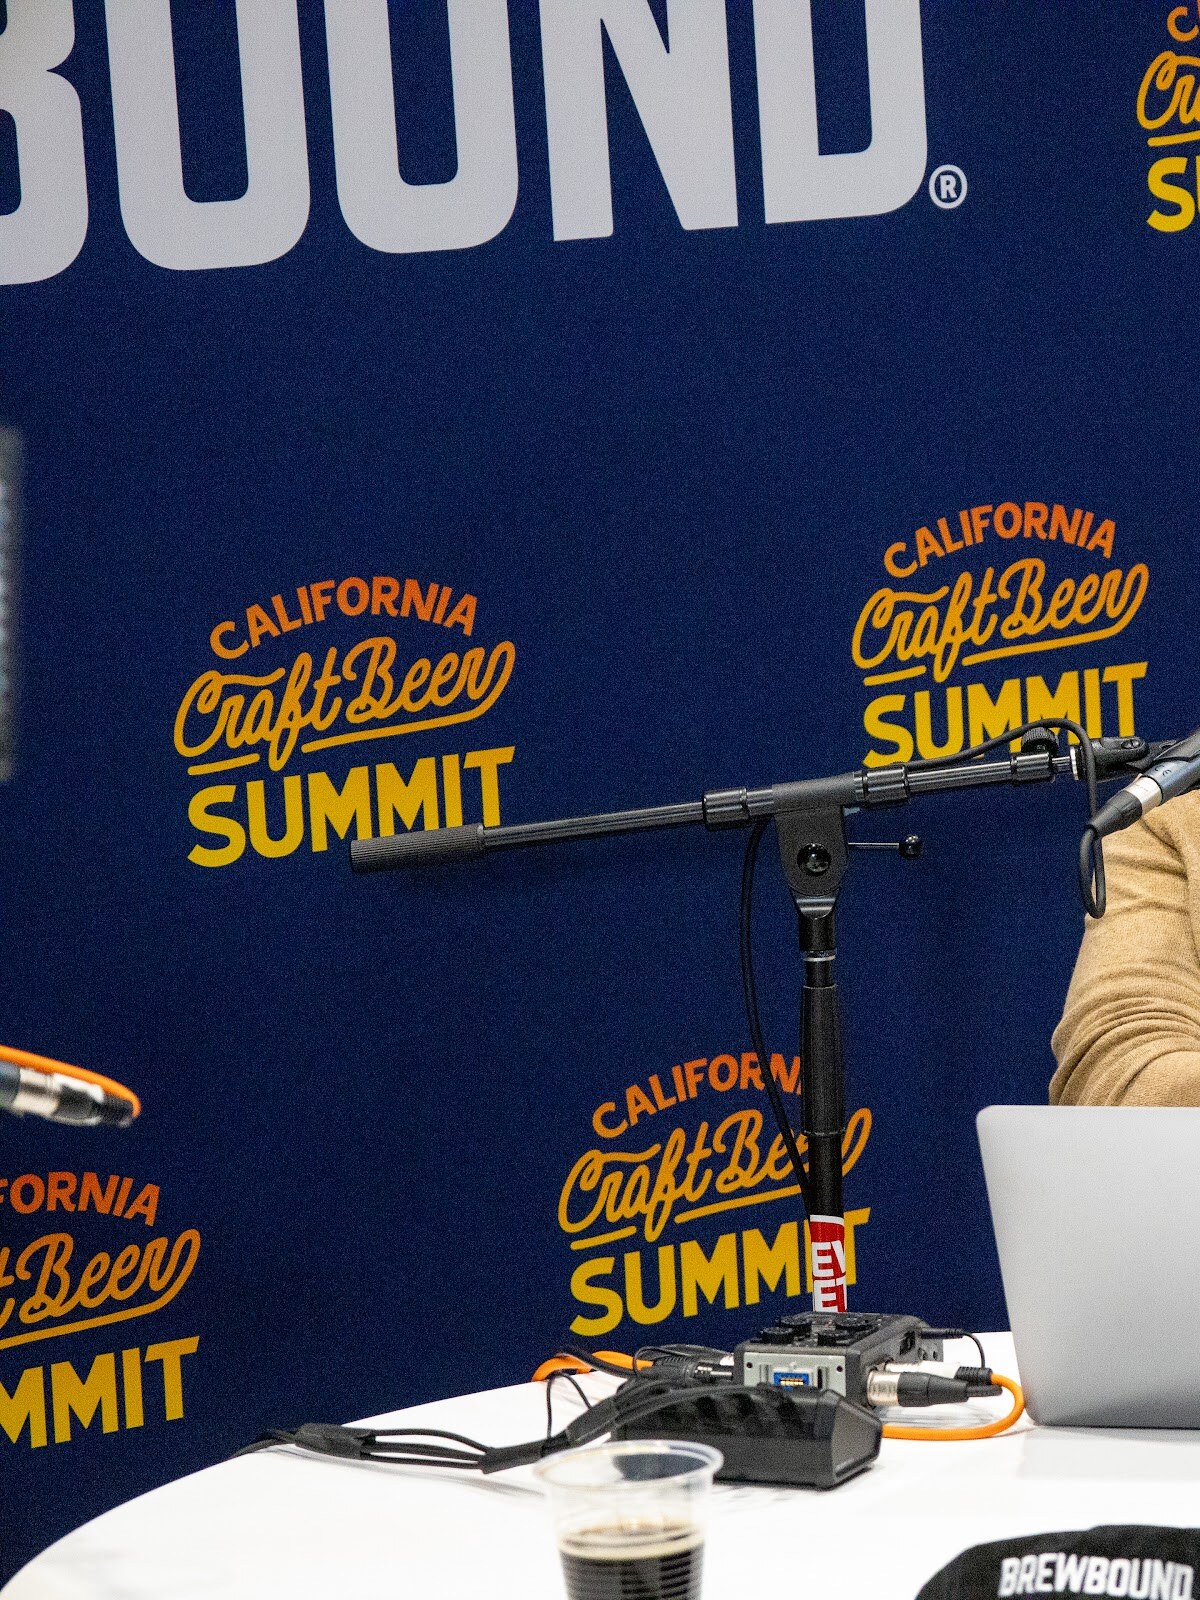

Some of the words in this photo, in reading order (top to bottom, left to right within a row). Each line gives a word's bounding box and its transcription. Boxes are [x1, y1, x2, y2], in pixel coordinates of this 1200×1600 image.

[884, 501, 1116, 578] CALIFORNIA
[210, 576, 478, 659] CALIFORNIA
[852, 566, 998, 683] Craft
[998, 557, 1149, 642] Beer
[173, 647, 343, 771] Craft
[342, 636, 516, 726] Beer
[863, 661, 1149, 768] SUMMIT
[187, 745, 516, 867] SUMMIT
[592, 1051, 801, 1138] CALIFORN
[0, 1171, 160, 1226] ORNIA
[558, 1121, 712, 1242] Craft
[15, 1229, 200, 1327] Beer
[999, 1552, 1195, 1600] BREWBOUND
